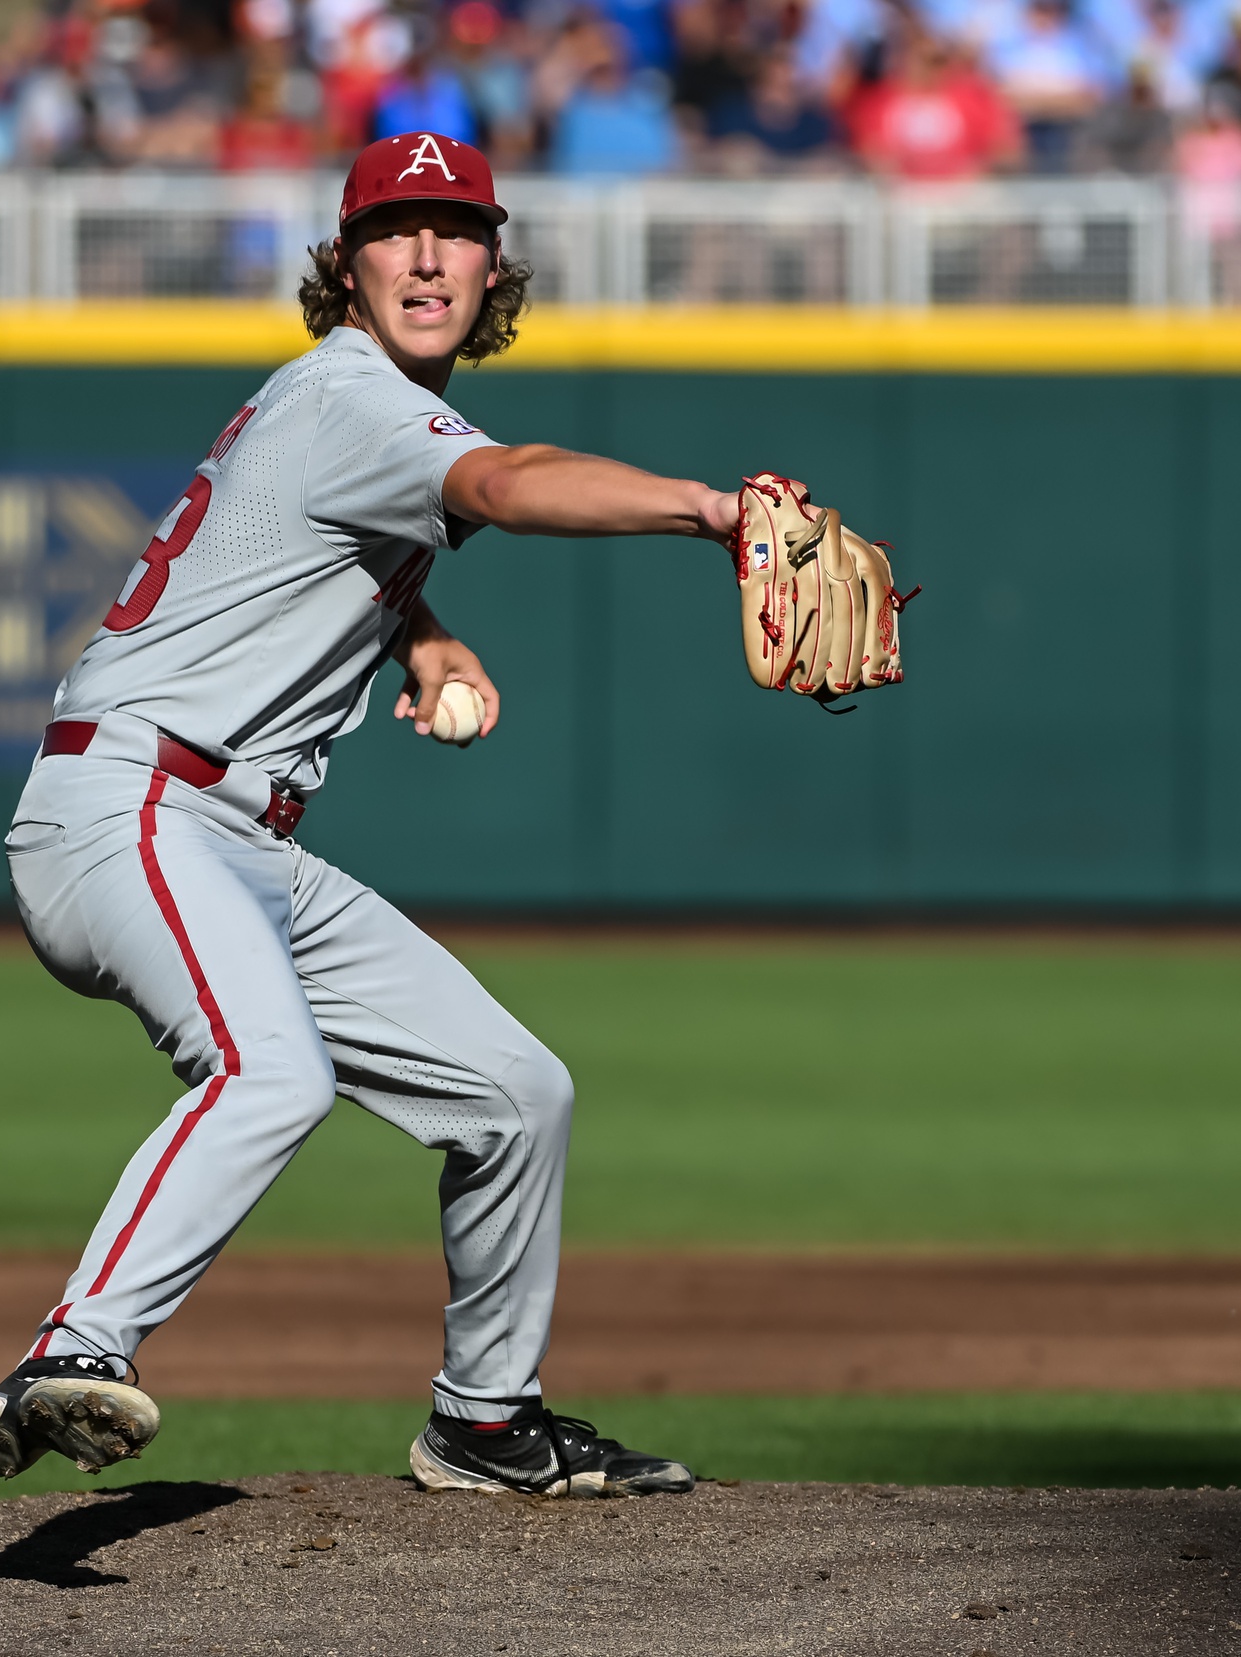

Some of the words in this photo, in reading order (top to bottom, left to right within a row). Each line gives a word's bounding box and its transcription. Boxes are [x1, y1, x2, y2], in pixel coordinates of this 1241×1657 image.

[397, 134, 456, 182] A
[779, 581, 788, 596] THE
[779, 597, 787, 618] GOLD
